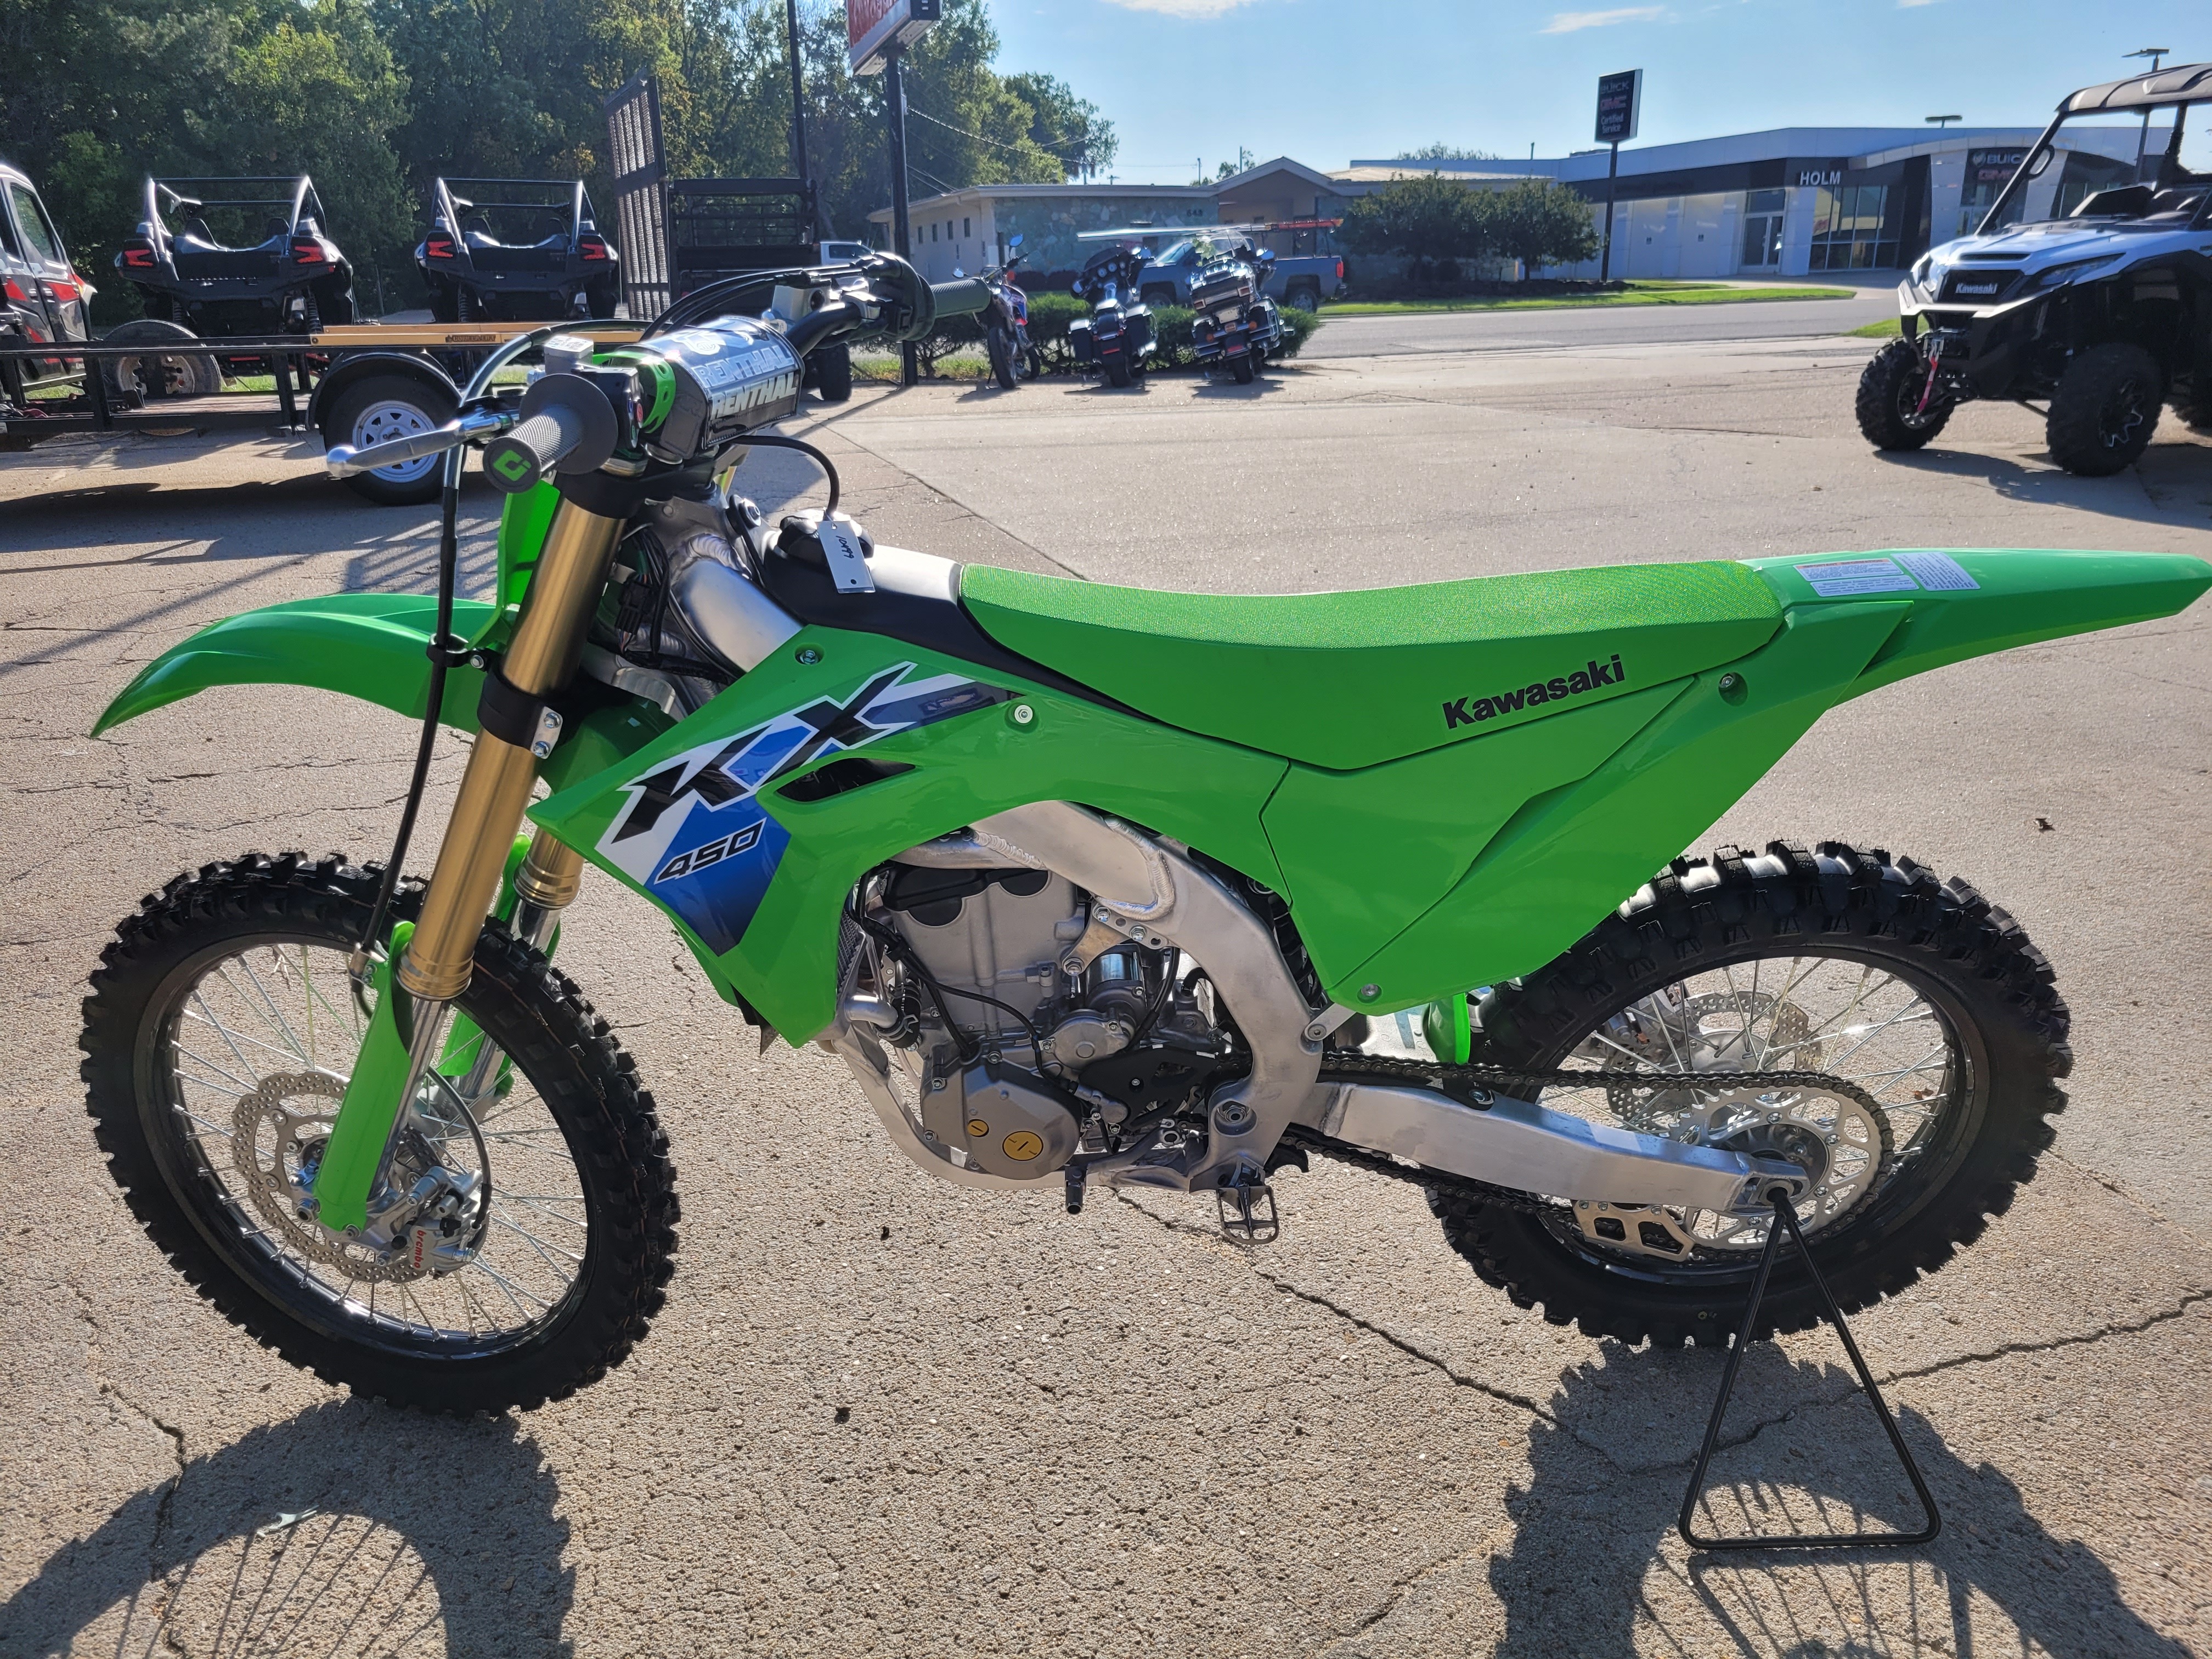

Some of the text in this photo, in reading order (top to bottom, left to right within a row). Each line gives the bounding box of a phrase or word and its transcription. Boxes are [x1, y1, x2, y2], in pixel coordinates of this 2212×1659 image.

[1600, 81, 1629, 94] BUICK
[1800, 171, 1841, 185] HOLM
[1987, 153, 2023, 164] BUIC
[1955, 283, 1997, 294] Kawasaki
[691, 345, 795, 388] RENTHAL
[711, 372, 798, 420] RENTHAL
[1442, 653, 1626, 730] Kawasaki
[610, 663, 917, 845] KX
[654, 817, 767, 885] 450
[414, 1229, 427, 1269] brembo
